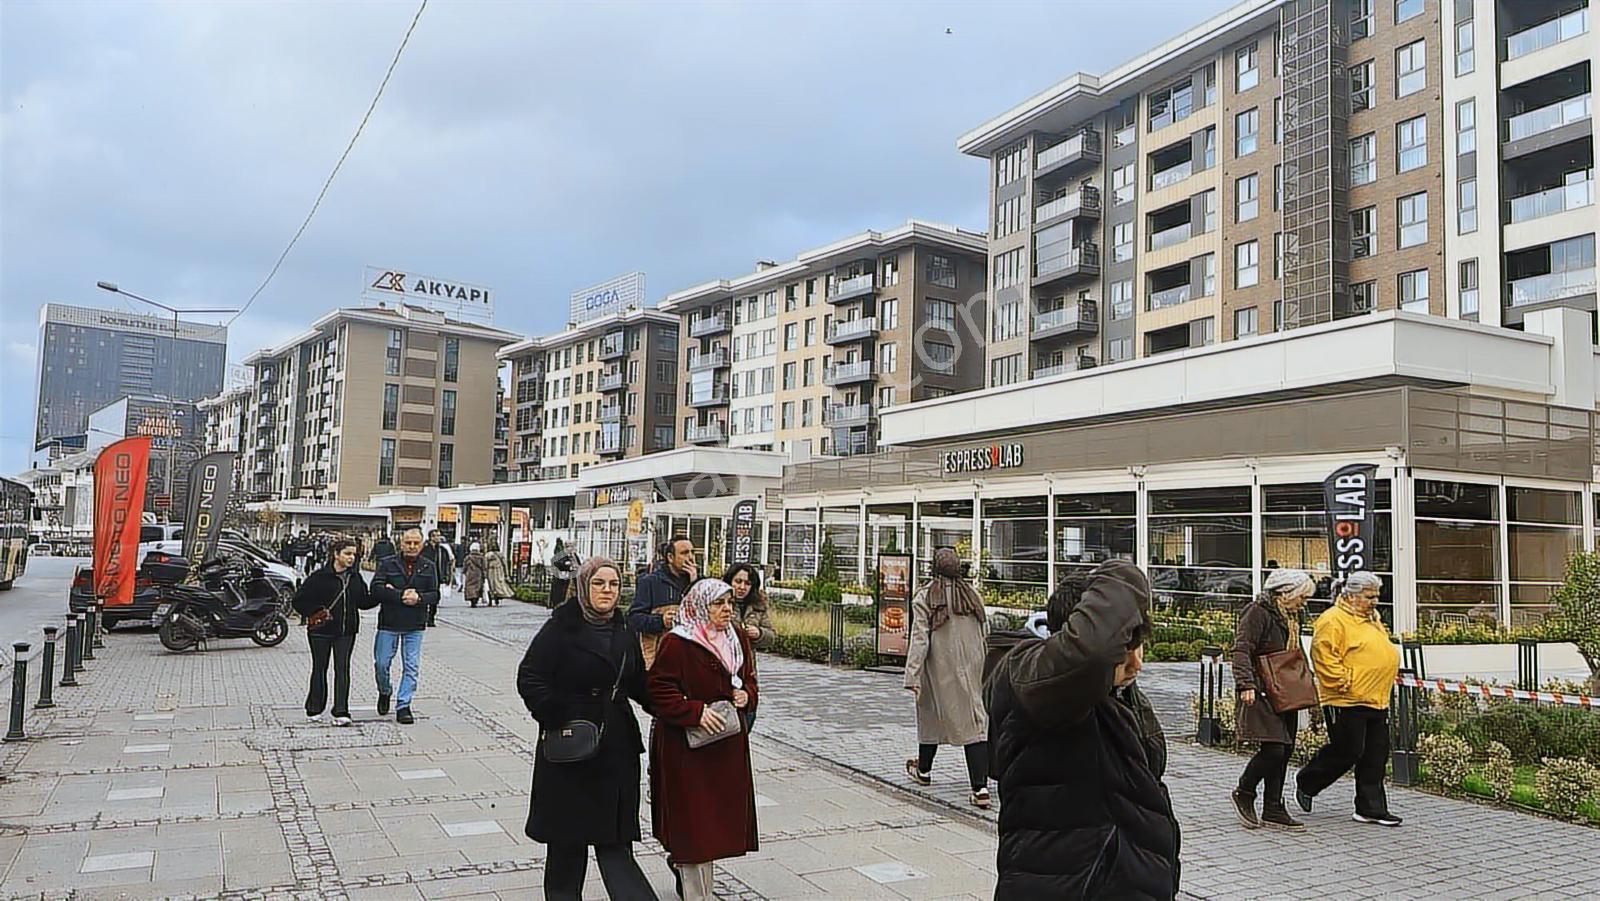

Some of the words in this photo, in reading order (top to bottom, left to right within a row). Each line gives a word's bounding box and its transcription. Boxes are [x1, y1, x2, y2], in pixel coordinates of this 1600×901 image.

[414, 280, 489, 304] AKYAPI
[114, 453, 131, 501] NEO
[200, 464, 218, 509] NEO
